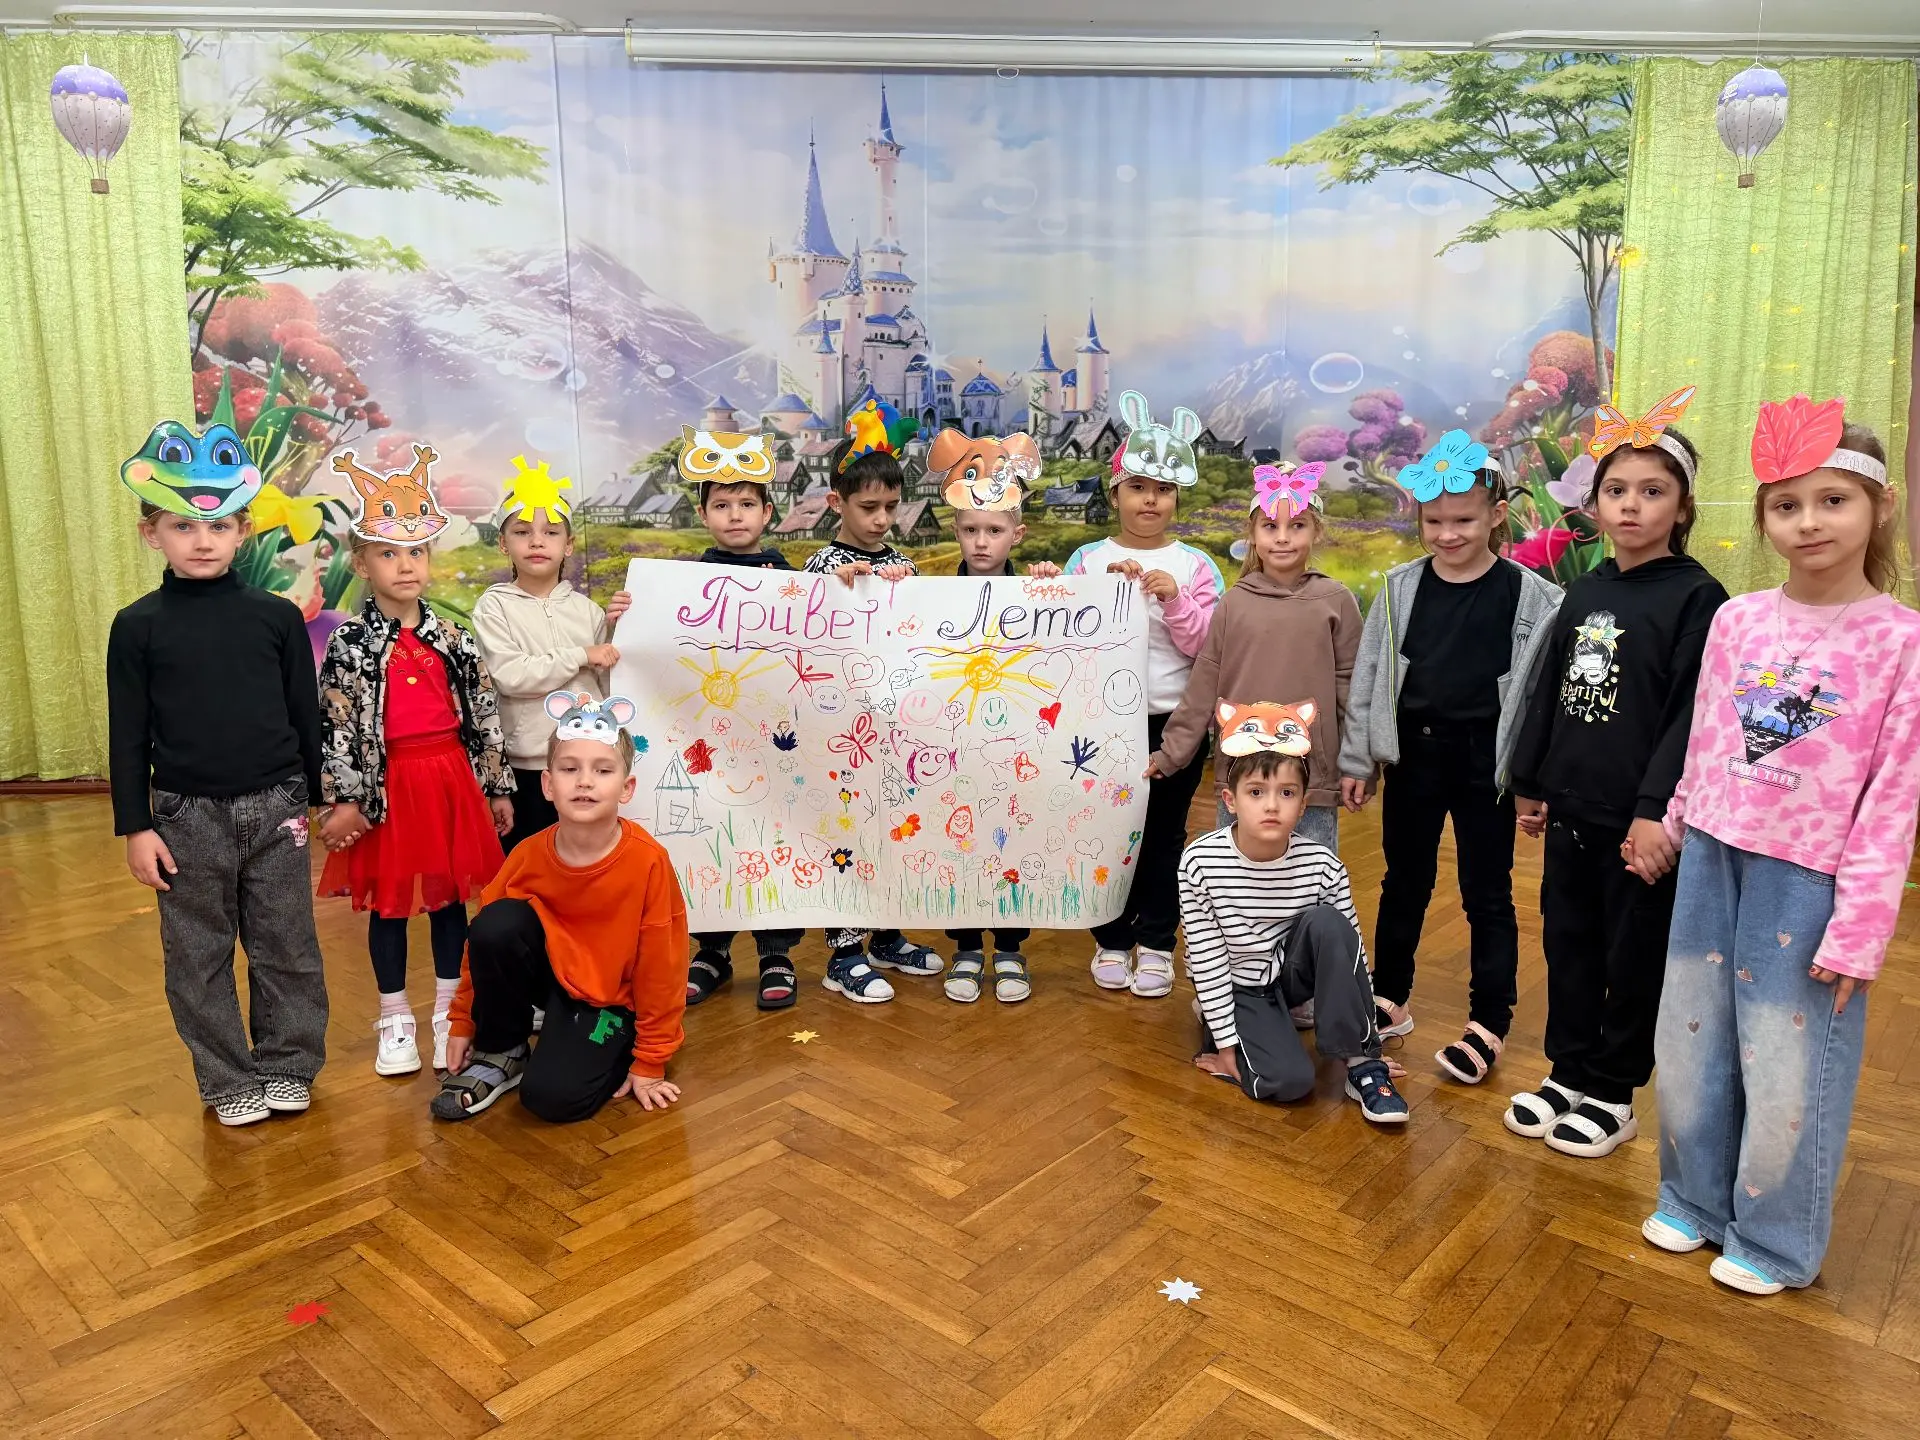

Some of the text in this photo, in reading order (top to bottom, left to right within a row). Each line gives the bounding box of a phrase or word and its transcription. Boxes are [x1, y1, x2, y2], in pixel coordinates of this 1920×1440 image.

[677, 575, 1133, 653] Привет! Лето!!!
[589, 1008, 623, 1044] F
